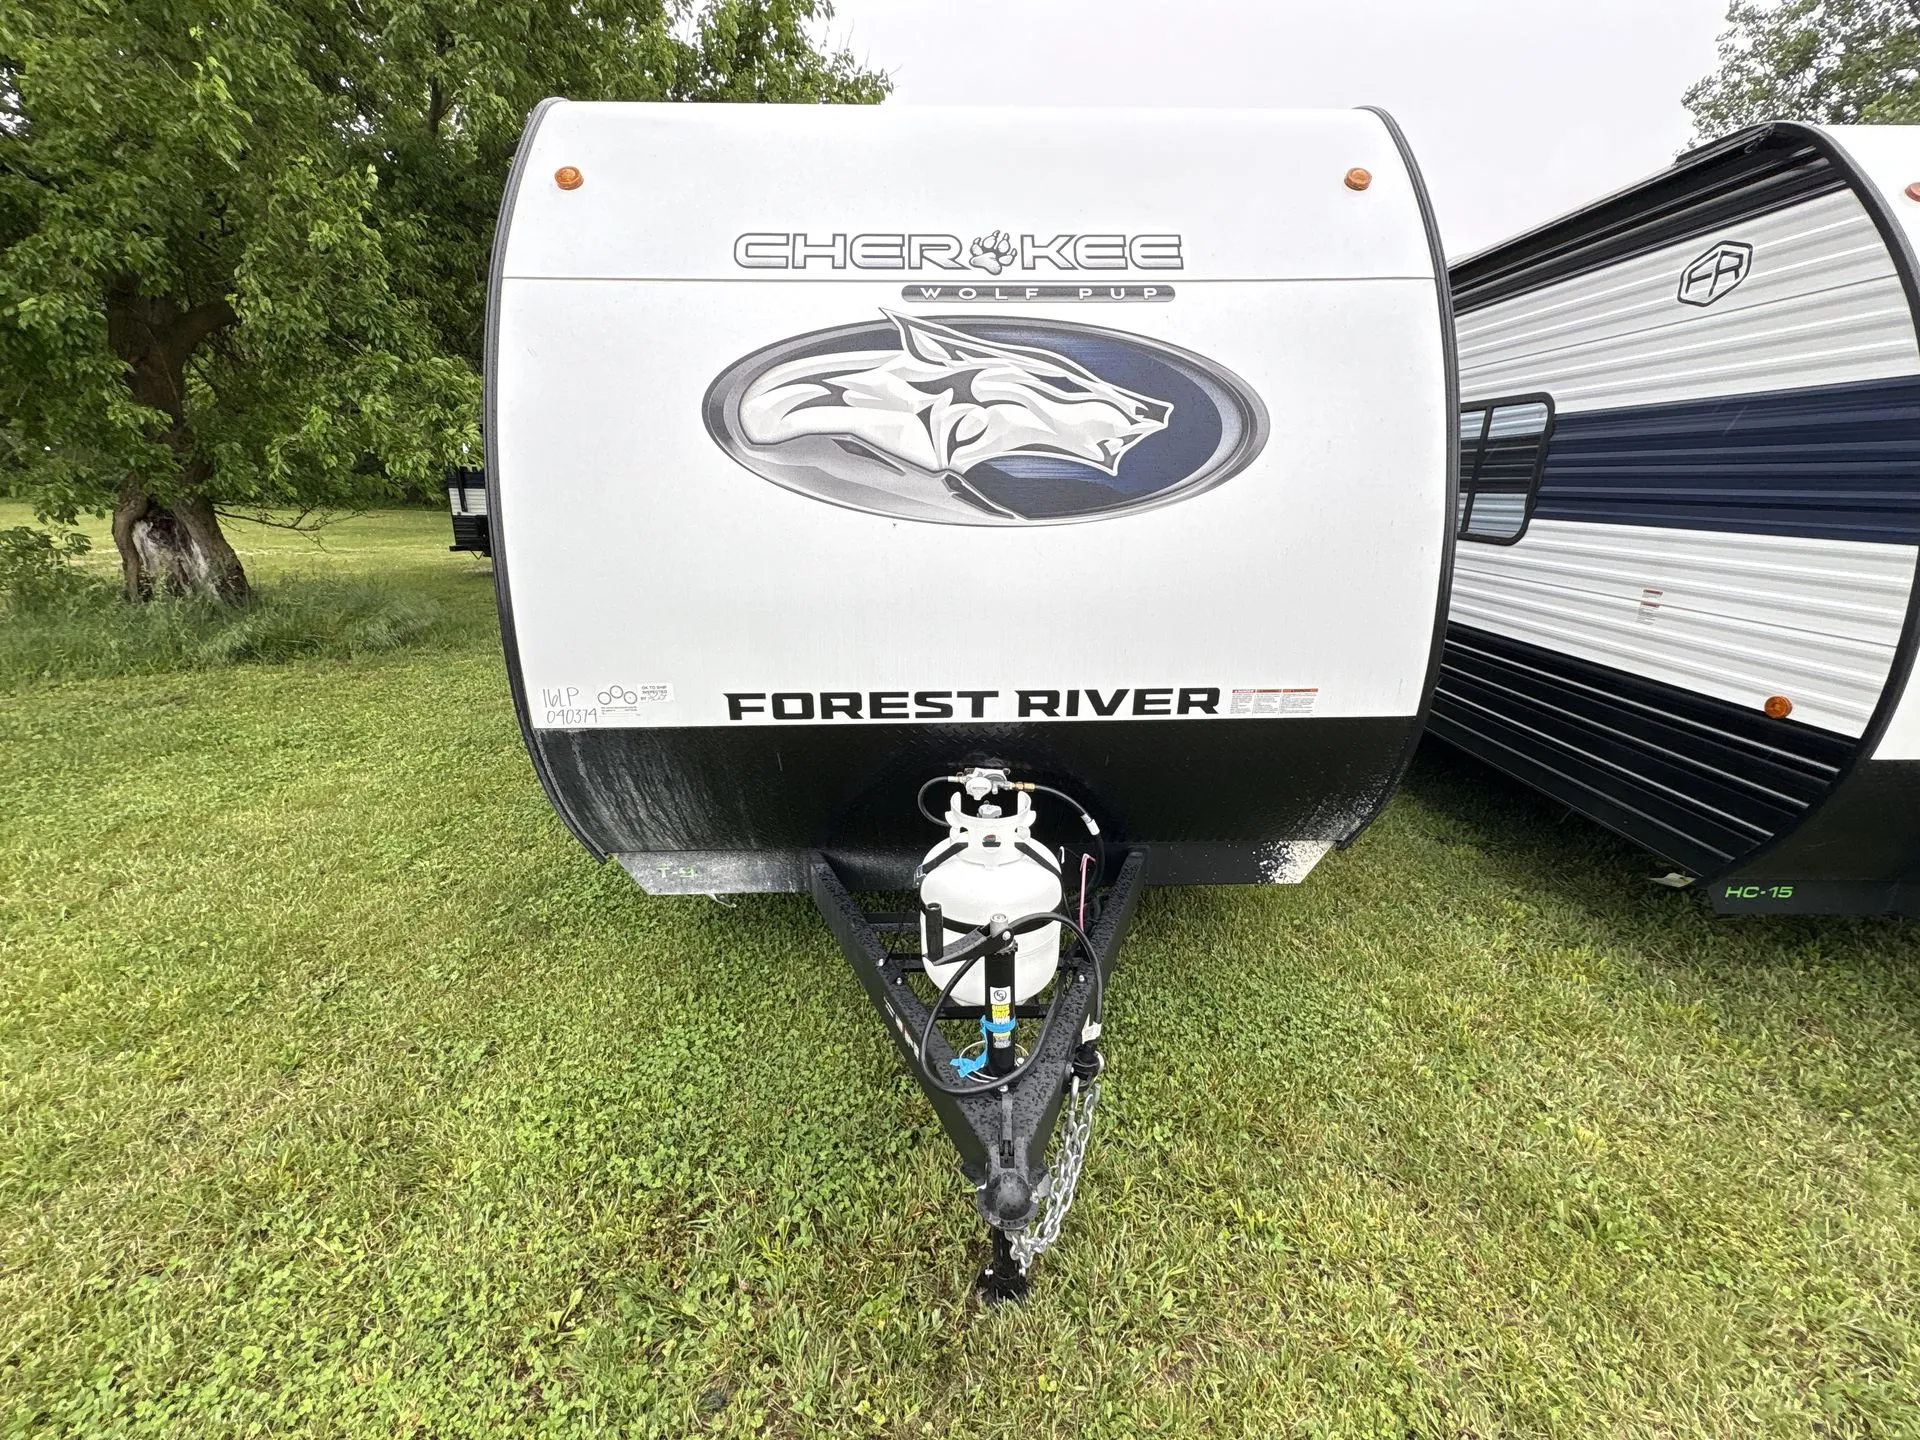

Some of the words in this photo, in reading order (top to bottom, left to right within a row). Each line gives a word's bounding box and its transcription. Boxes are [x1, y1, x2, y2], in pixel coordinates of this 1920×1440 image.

[919, 287, 1039, 300] WOLF
[1078, 287, 1158, 300] PUP
[723, 690, 999, 720] FOREST
[1014, 687, 1221, 717] RIVER
[1724, 886, 1794, 898] HC-15
